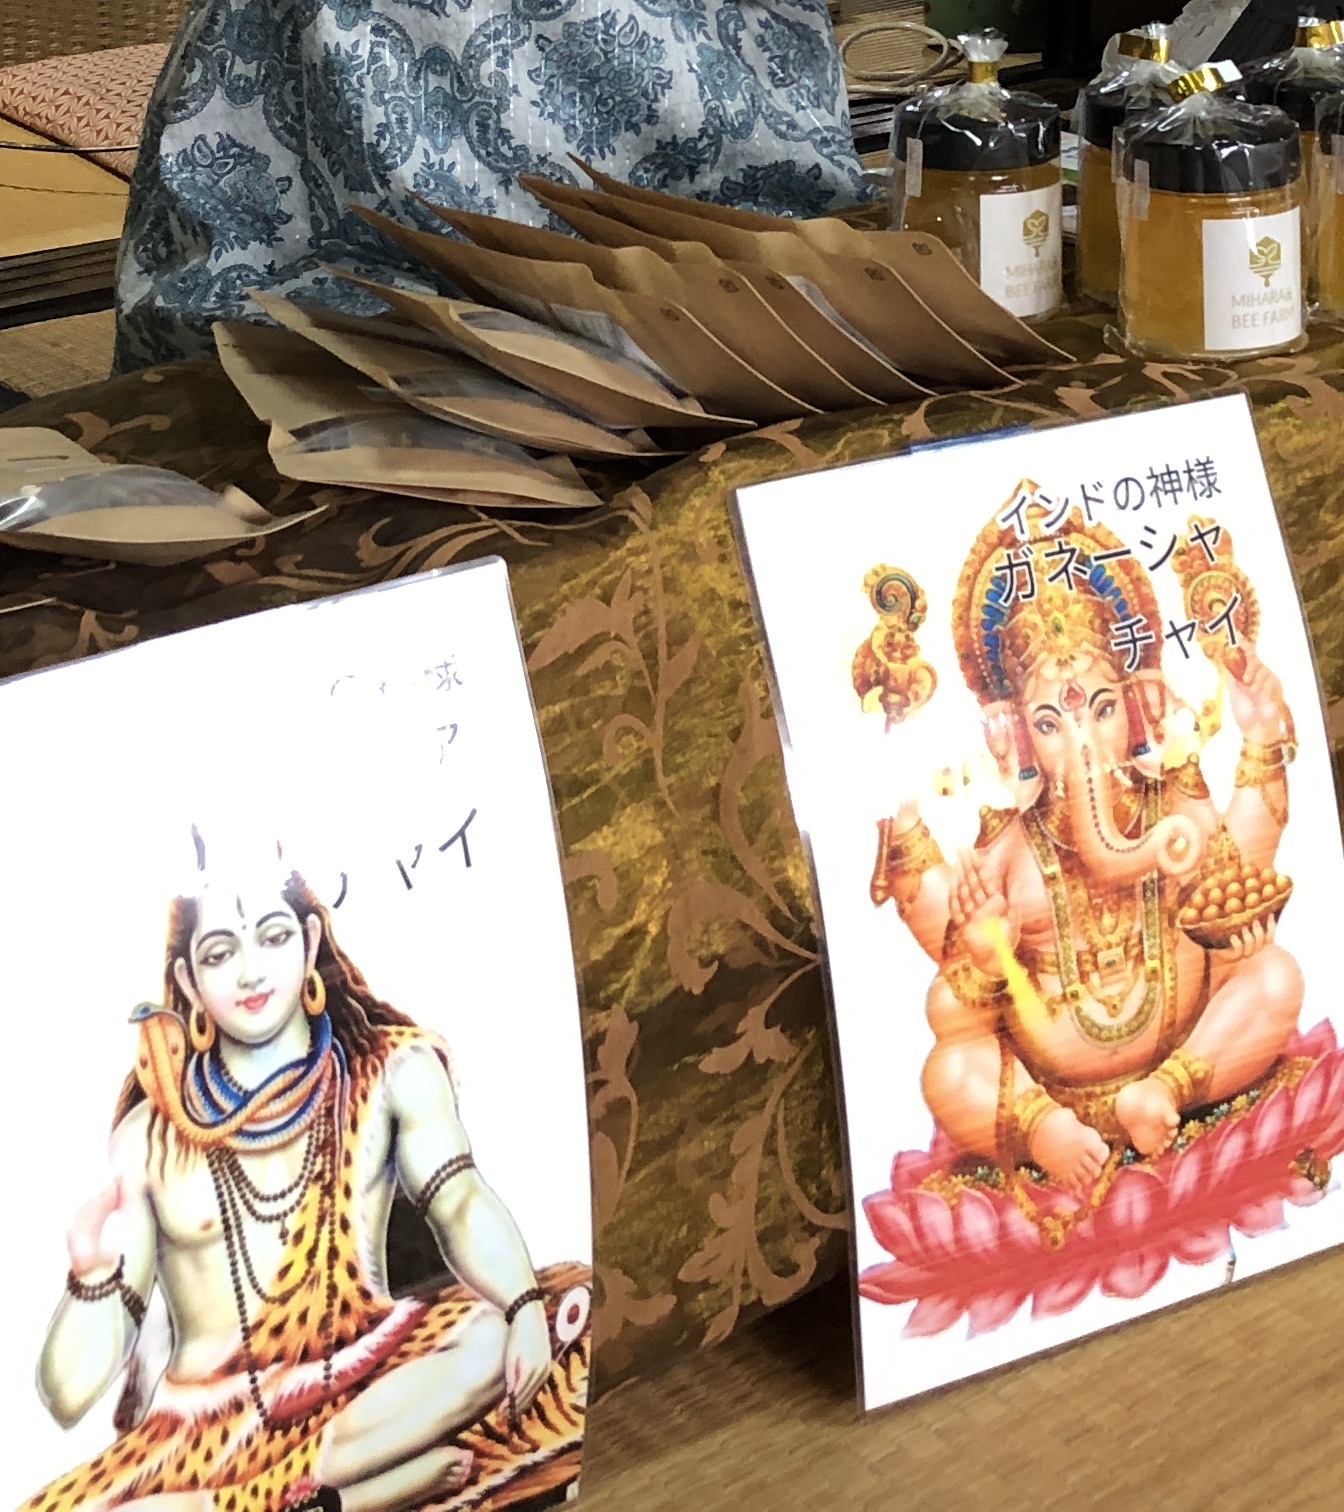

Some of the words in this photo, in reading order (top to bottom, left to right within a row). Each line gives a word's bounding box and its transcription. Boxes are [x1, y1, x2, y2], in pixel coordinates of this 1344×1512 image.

[1231, 312, 1260, 329] BEE
[1000, 456, 1222, 537] インドの神様
[994, 522, 1222, 604] ガネーシャ
[1112, 595, 1241, 670] チャイ
